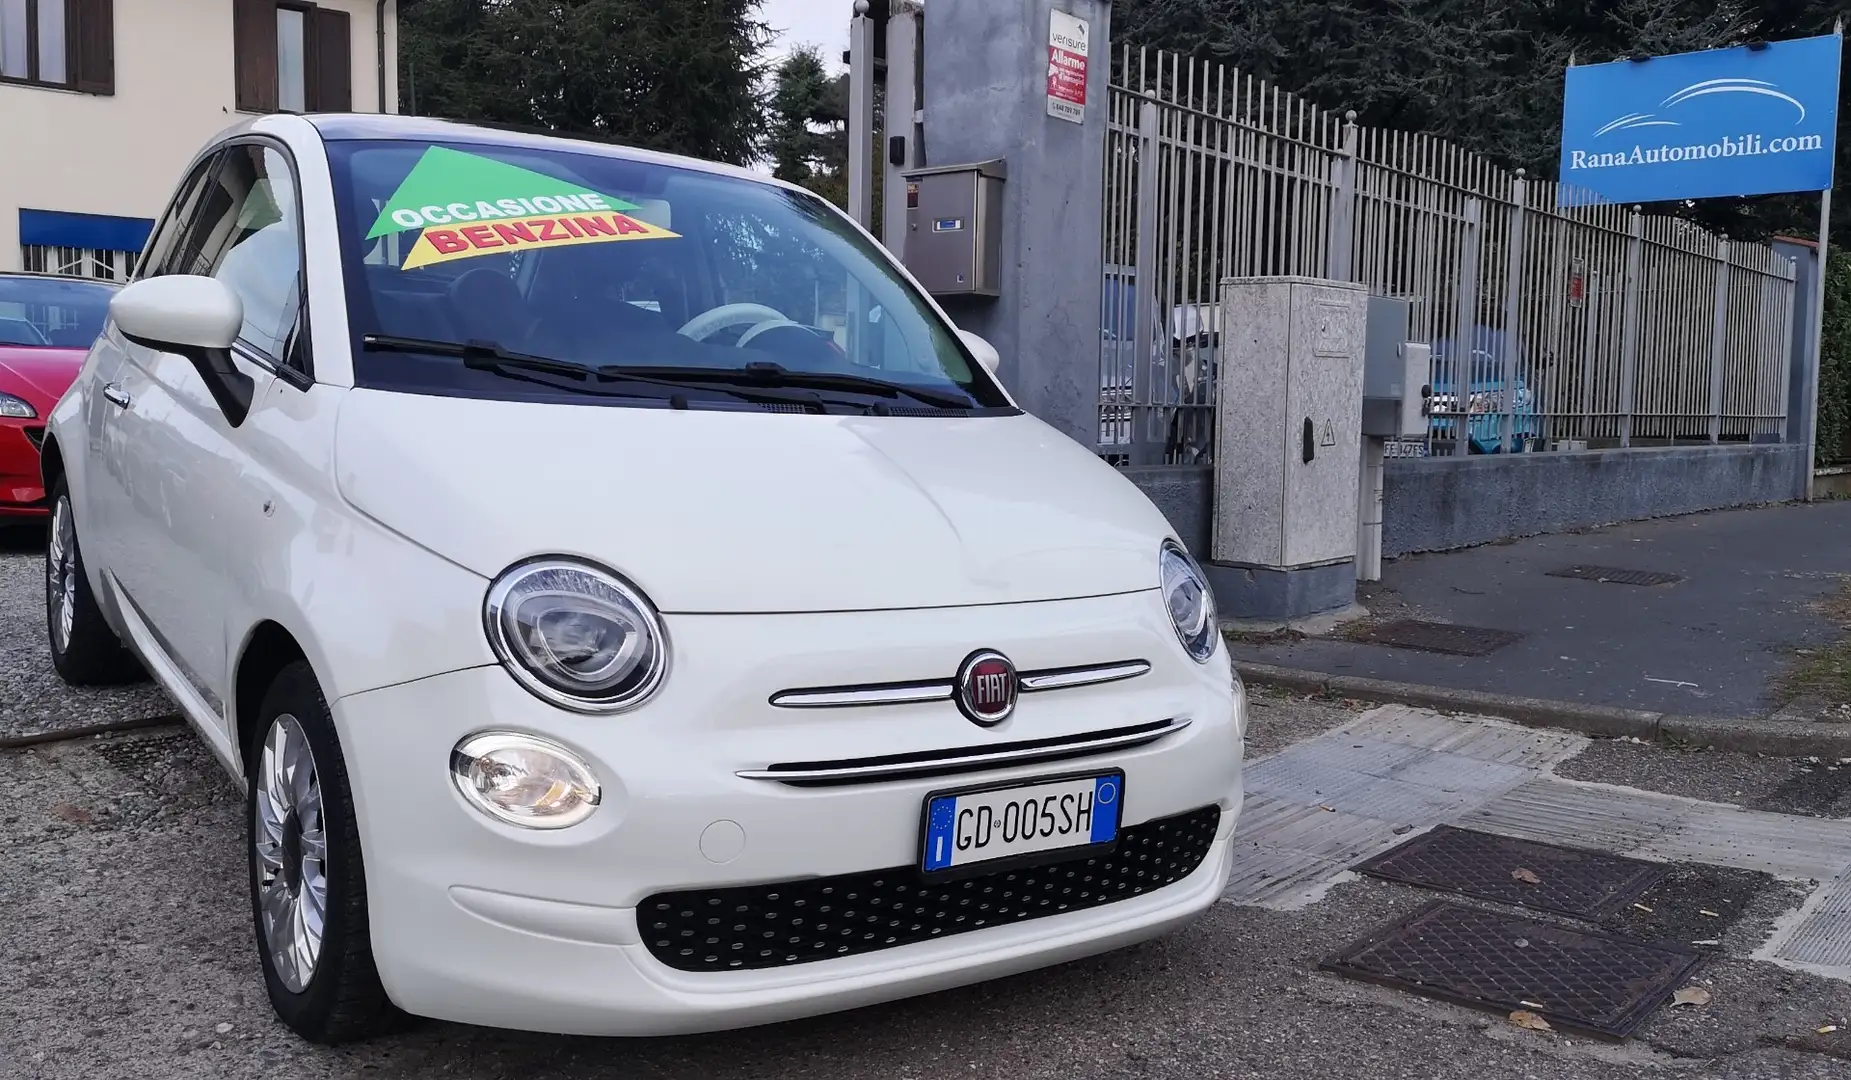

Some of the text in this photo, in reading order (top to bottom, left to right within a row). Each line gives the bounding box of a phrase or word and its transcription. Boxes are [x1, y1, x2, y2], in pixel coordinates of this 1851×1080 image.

[1052, 32, 1086, 51] verisure
[1051, 49, 1085, 70] Allarme
[1570, 134, 1822, 170] RanaAutomobili.com
[391, 193, 612, 228] OCCASIONE
[424, 214, 649, 255] BENZINA
[976, 673, 1007, 704] FIAT
